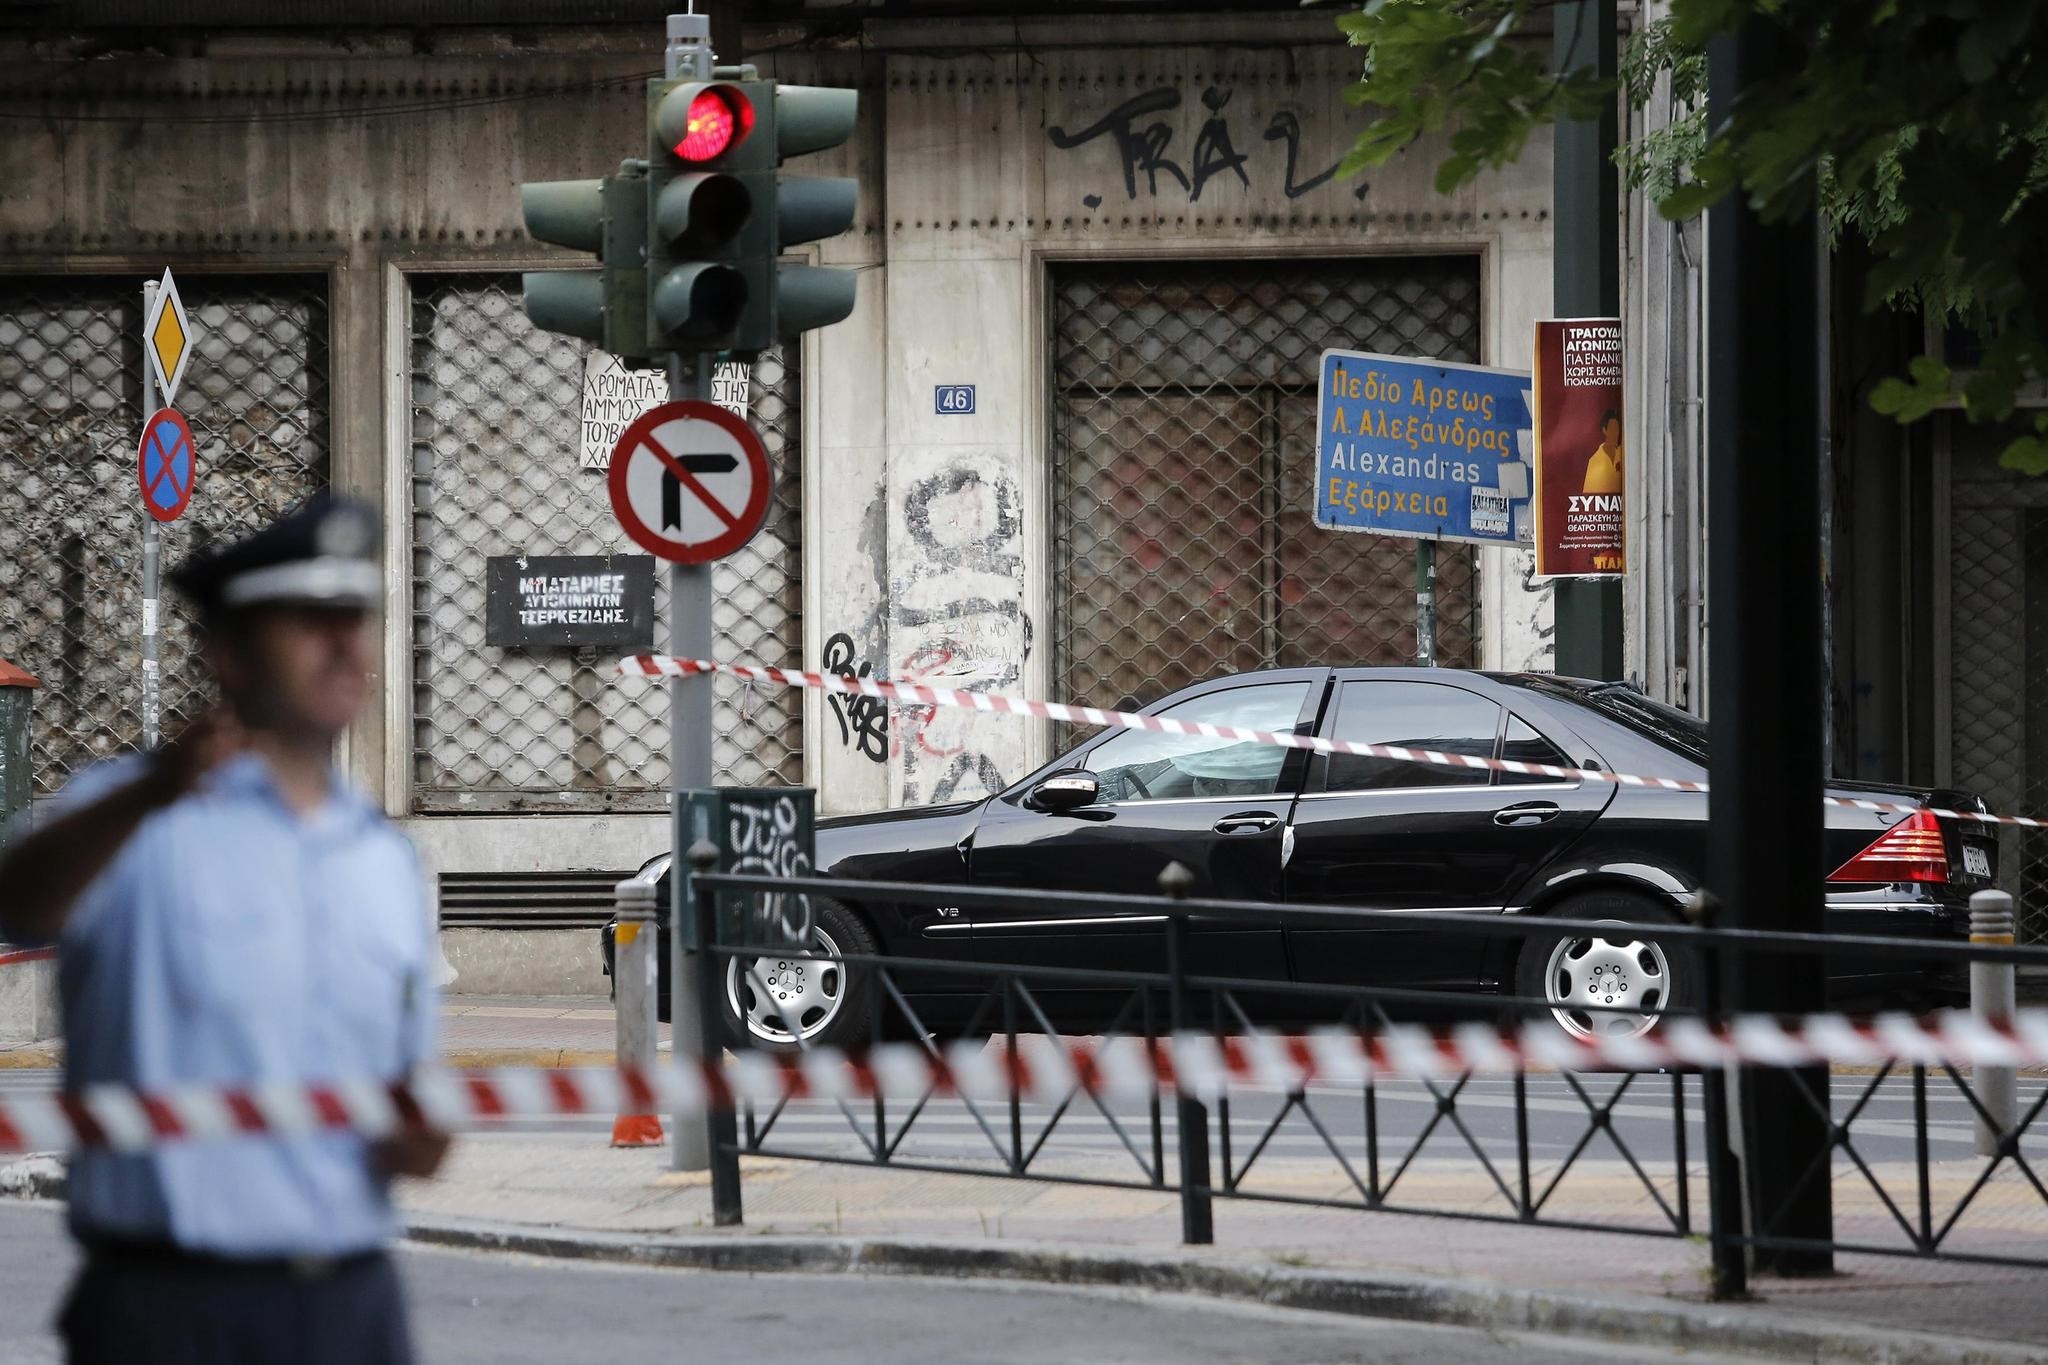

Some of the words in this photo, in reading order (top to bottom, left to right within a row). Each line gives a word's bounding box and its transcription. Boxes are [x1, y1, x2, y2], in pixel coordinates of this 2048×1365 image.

[1566, 353, 1584, 365] ΓΙΑ
[1566, 367, 1594, 376] ΧΩΡΙΣ
[1333, 369, 1401, 403] Πεδίο
[943, 390, 967, 409] 46
[1331, 406, 1351, 434] Λ.
[1359, 409, 1510, 457] Αλεξάνδρας
[1330, 442, 1480, 483] Alexandras
[1328, 477, 1449, 517] Εξάρχεια
[1567, 514, 1611, 523] ΠΑΡΑΣΚΕΥΗ
[1567, 524, 1596, 532] ΘΕΑΤΡΟ
[519, 574, 625, 594] ΜΠΑΤΑΡΙΕΣ
[524, 594, 621, 608] ΑΥΤΟΚΙΝΗΤΩΝ
[936, 907, 959, 917] V8
